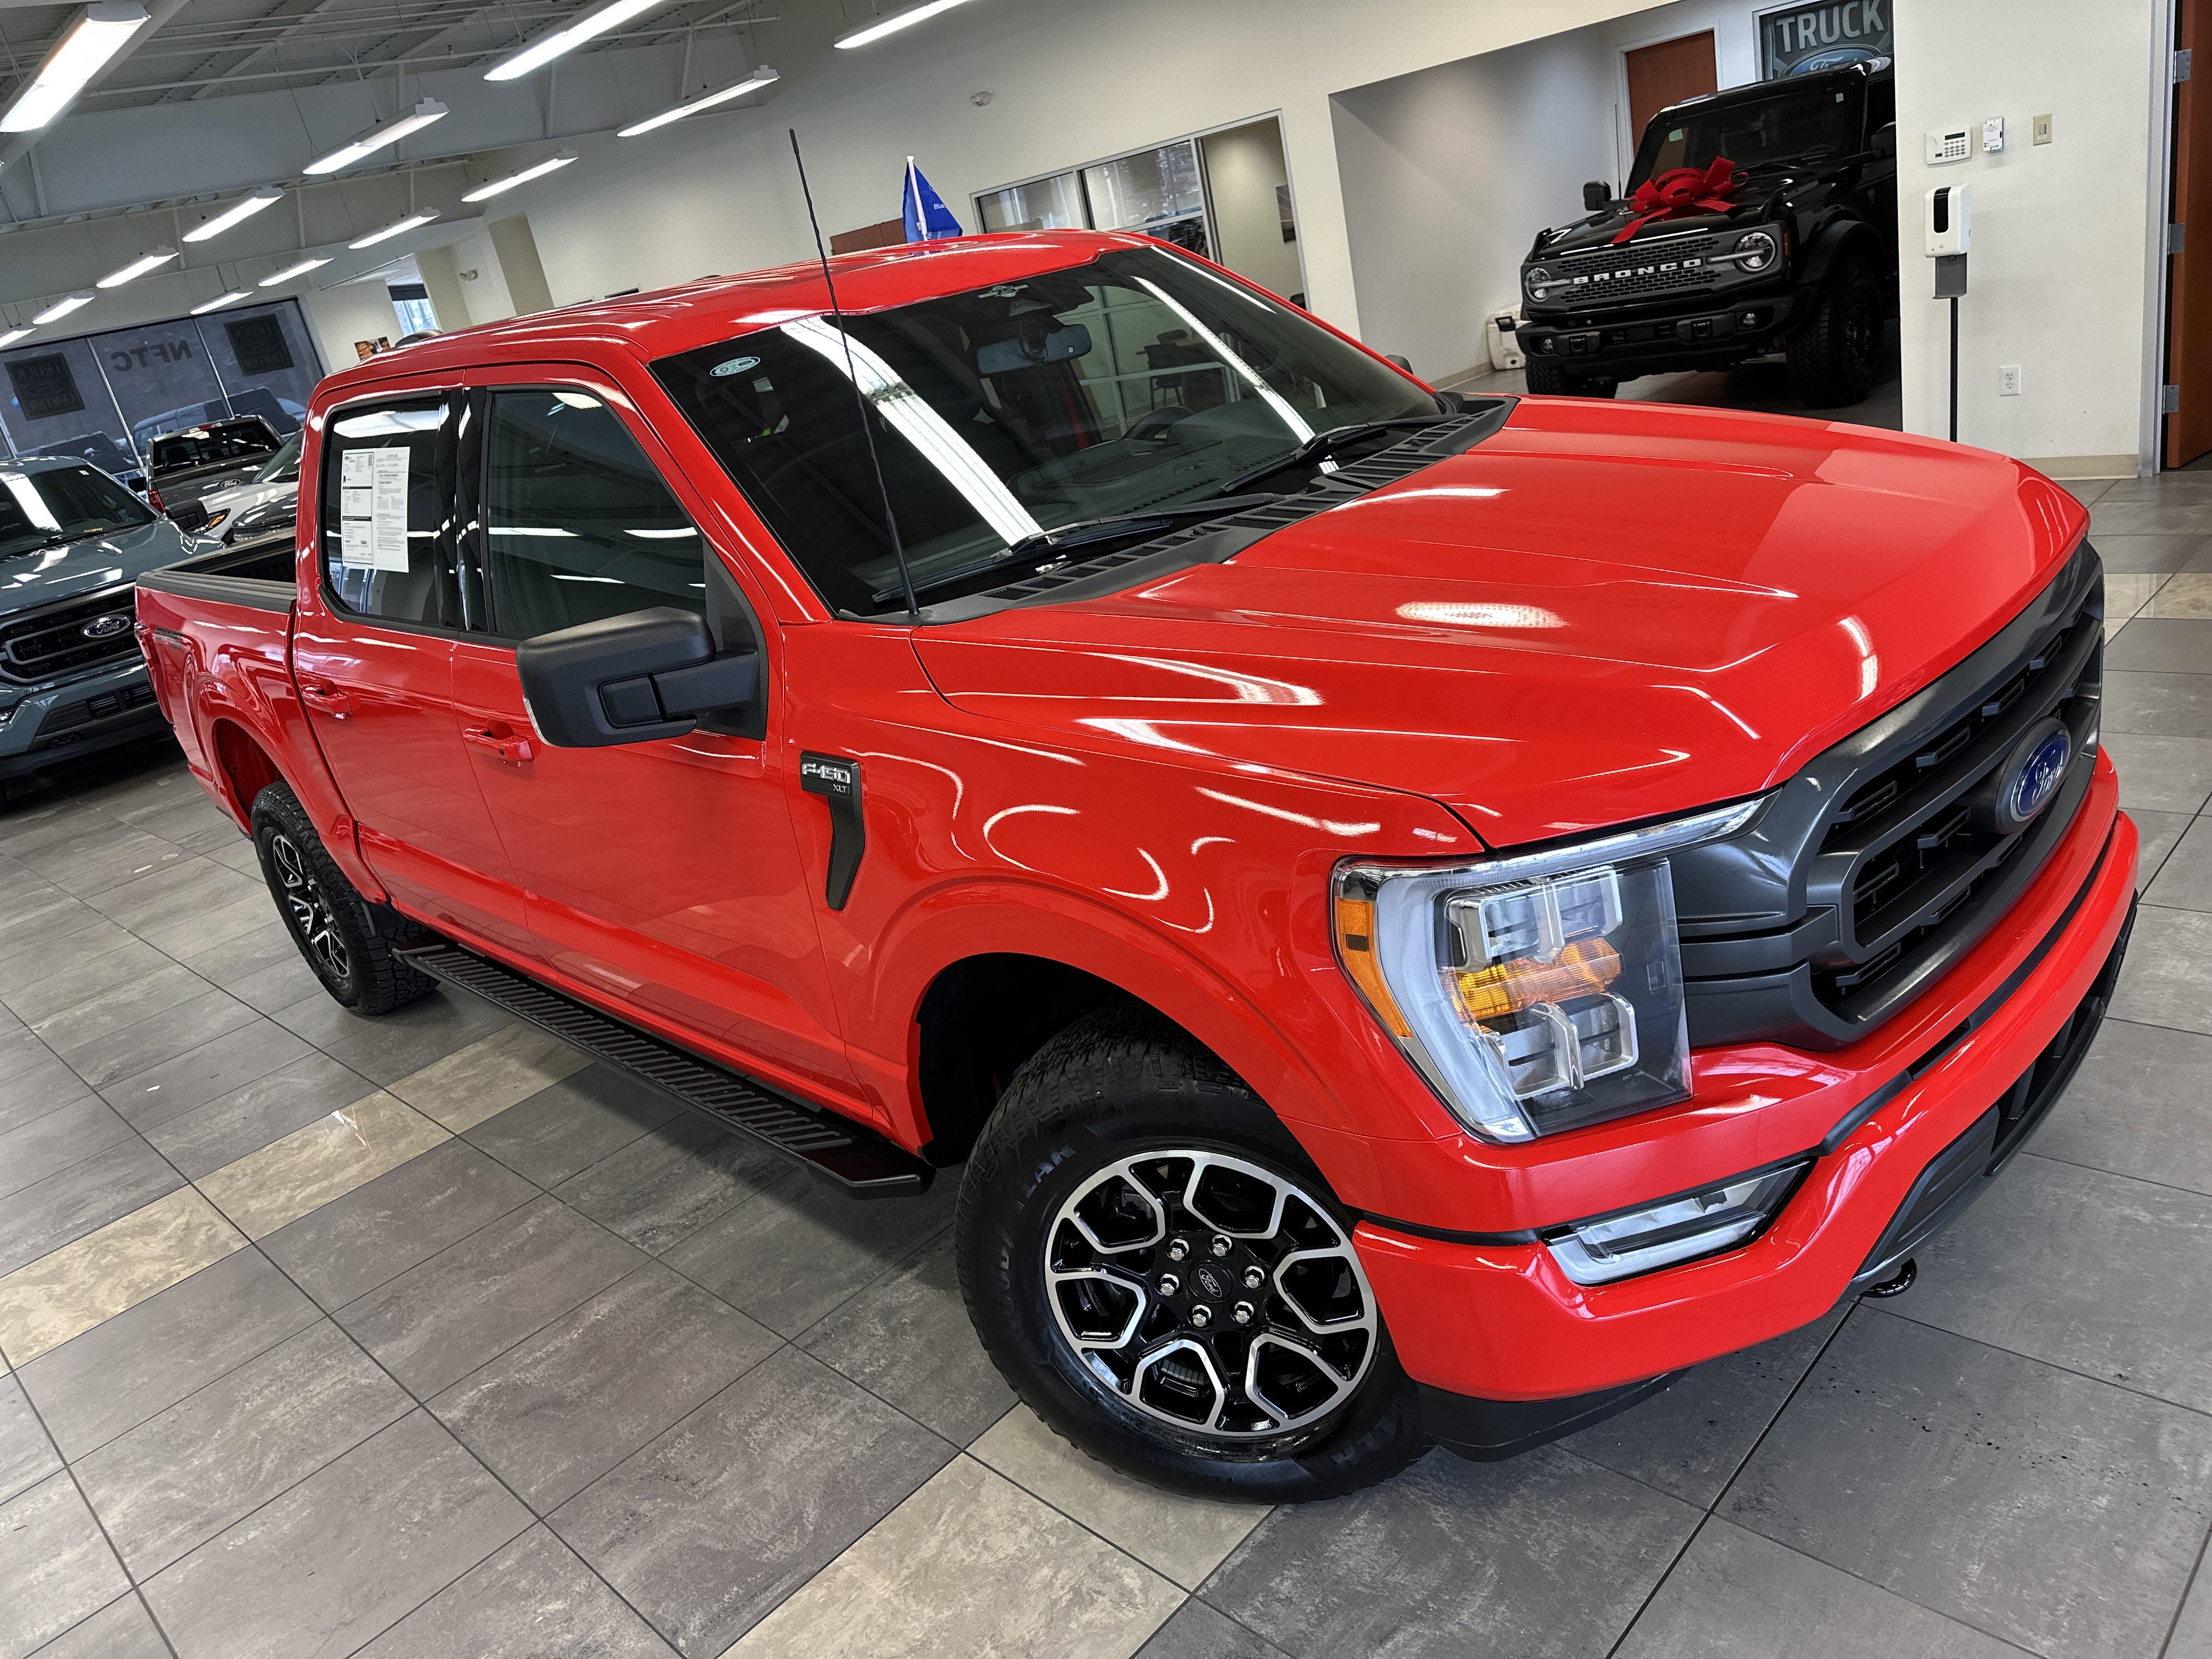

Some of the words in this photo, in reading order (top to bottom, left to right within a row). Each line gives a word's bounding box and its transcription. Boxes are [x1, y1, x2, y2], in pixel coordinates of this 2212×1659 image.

[1776, 0, 1884, 53] TRUCK
[1573, 258, 1701, 285] BRONCO
[96, 620, 121, 634] Ford
[833, 783, 847, 793] XLT
[2032, 749, 2064, 806] Ford
[1201, 1274, 1219, 1293] Ford
